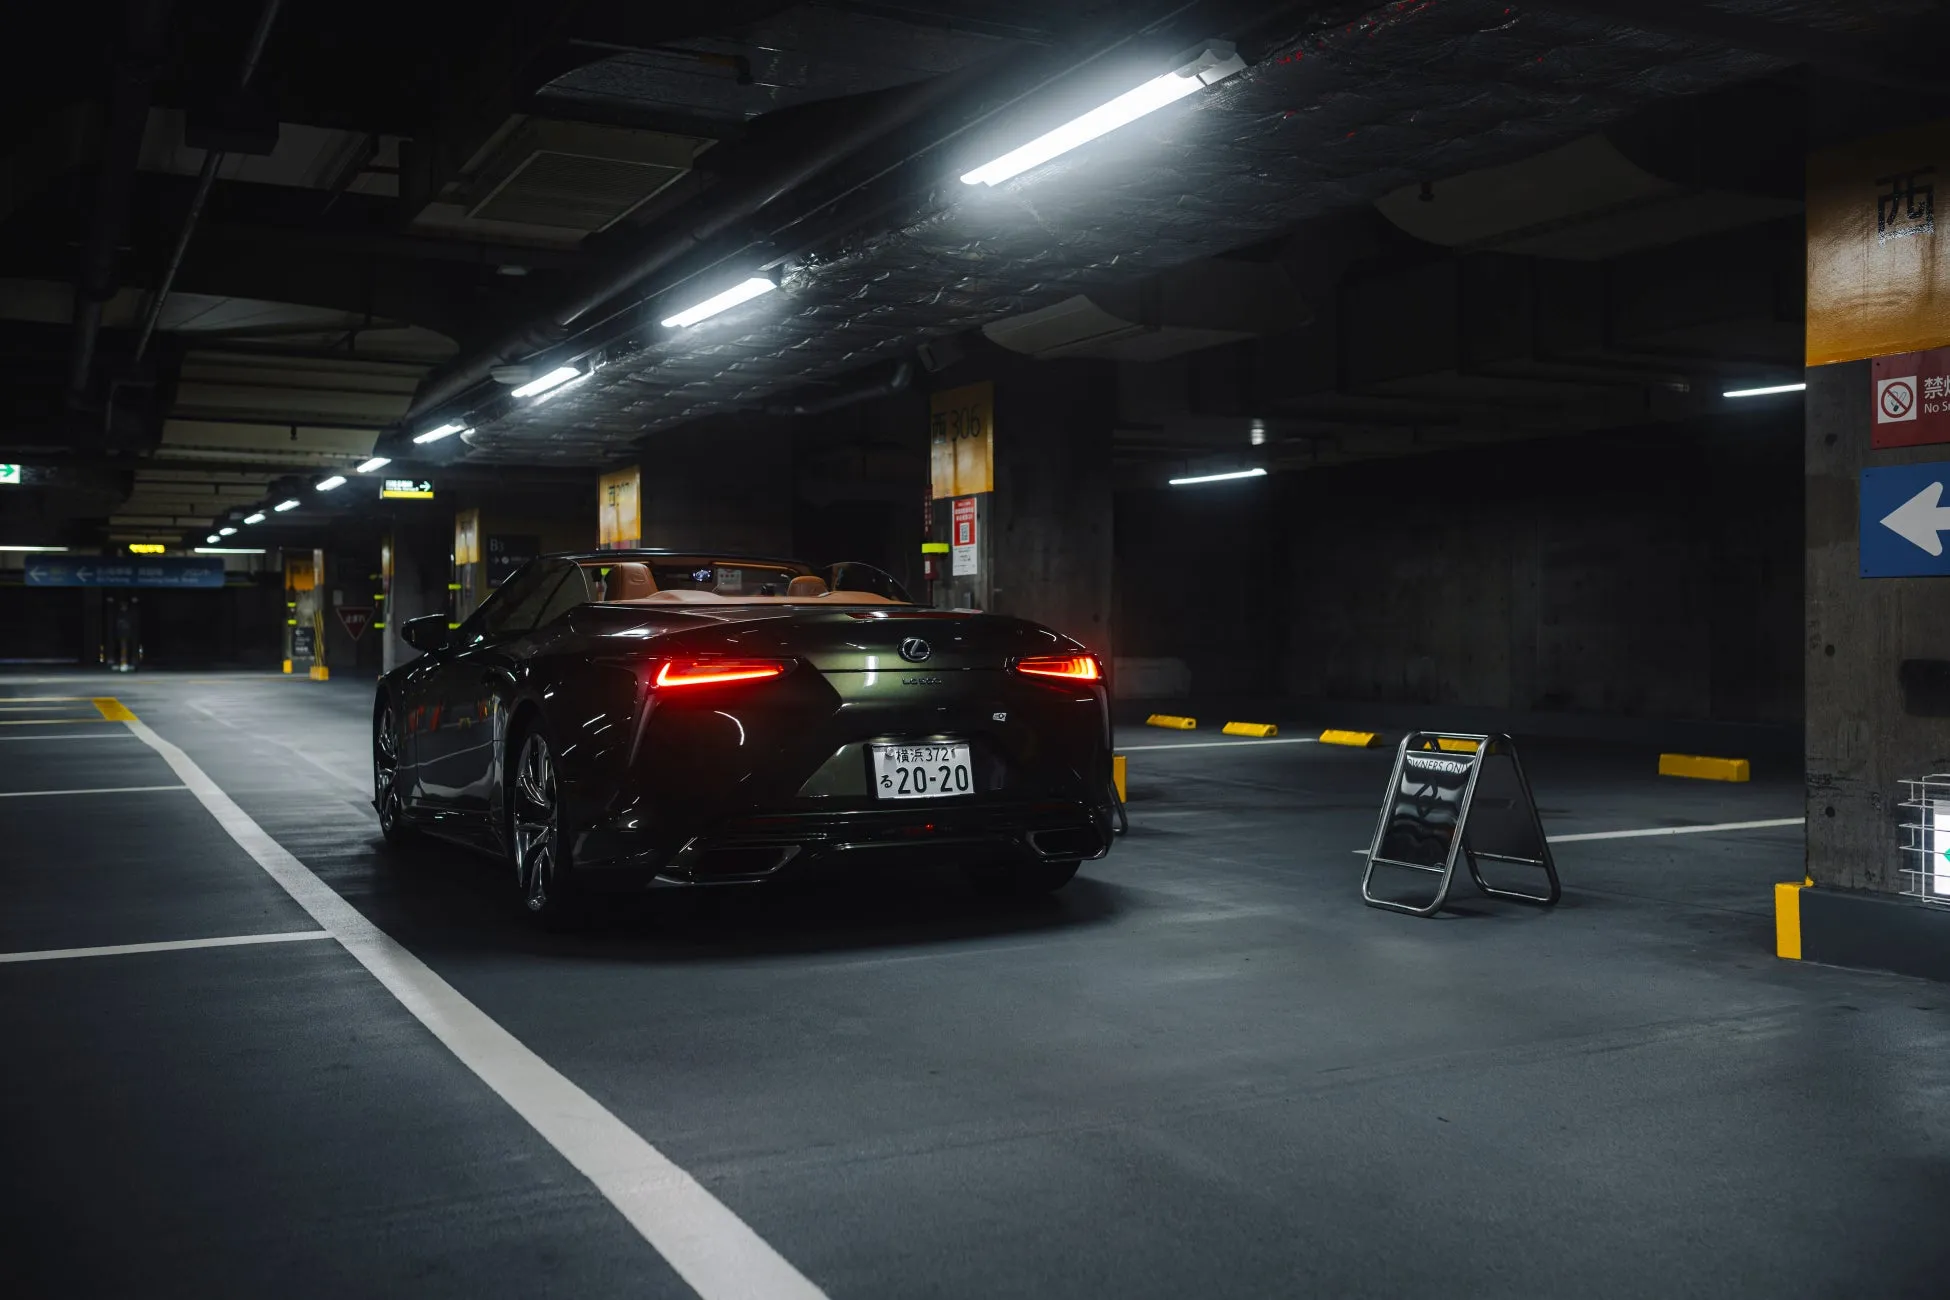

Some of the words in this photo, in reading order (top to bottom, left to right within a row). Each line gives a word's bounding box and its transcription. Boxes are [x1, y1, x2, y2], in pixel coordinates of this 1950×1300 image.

[1876, 166, 1936, 247] 西
[1924, 402, 1940, 414] No
[1942, 400, 1950, 412] S
[880, 774, 893, 789] る
[896, 764, 969, 795] 20-20
